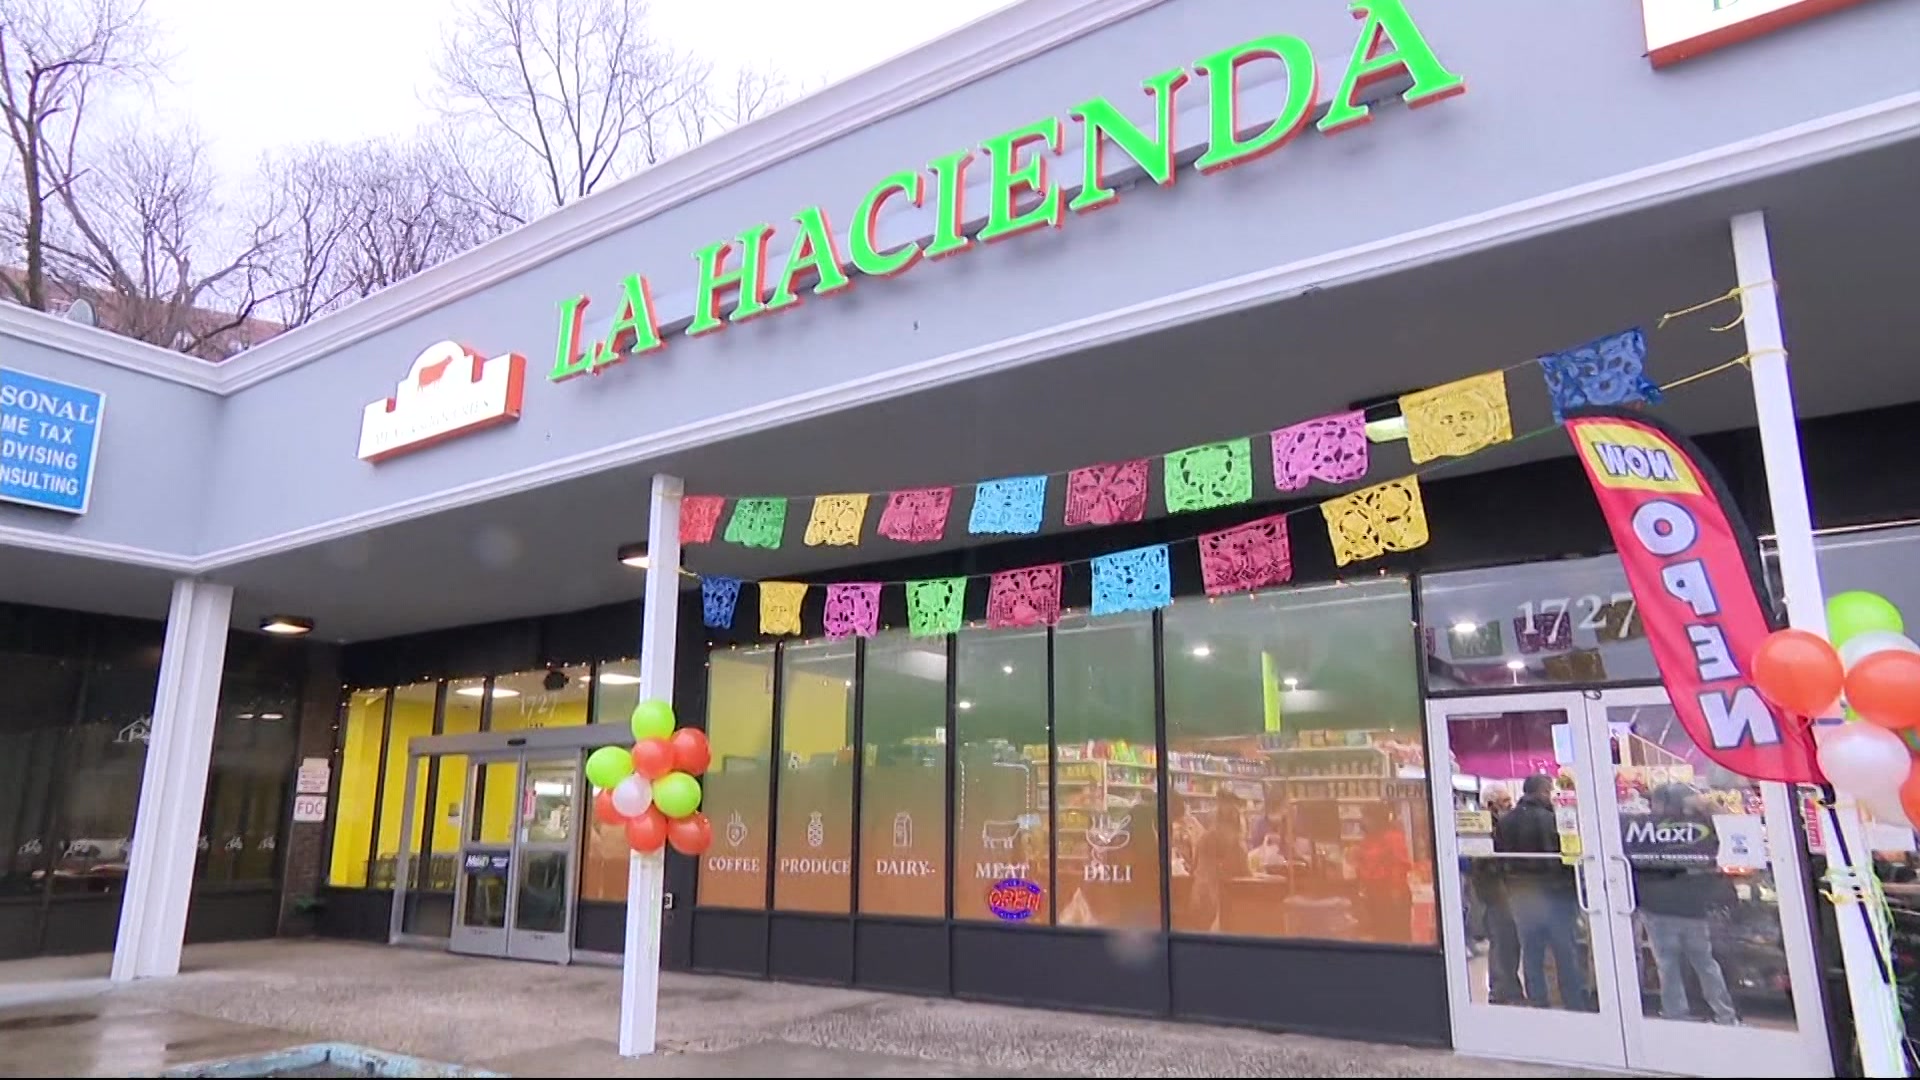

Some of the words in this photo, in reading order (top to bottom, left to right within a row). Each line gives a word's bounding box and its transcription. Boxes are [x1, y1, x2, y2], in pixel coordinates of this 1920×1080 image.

[545, 272, 662, 382] LA
[685, 0, 1464, 336] HACIENDA
[39, 421, 74, 445] TAX
[2, 440, 78, 470] DVISING
[1517, 592, 1636, 643] 1727
[1626, 820, 1695, 844] Maxi
[708, 856, 760, 873] COFFEE
[780, 857, 850, 875] PRODUCE
[975, 862, 1030, 879] MEAT
[1083, 863, 1132, 881] DELI
